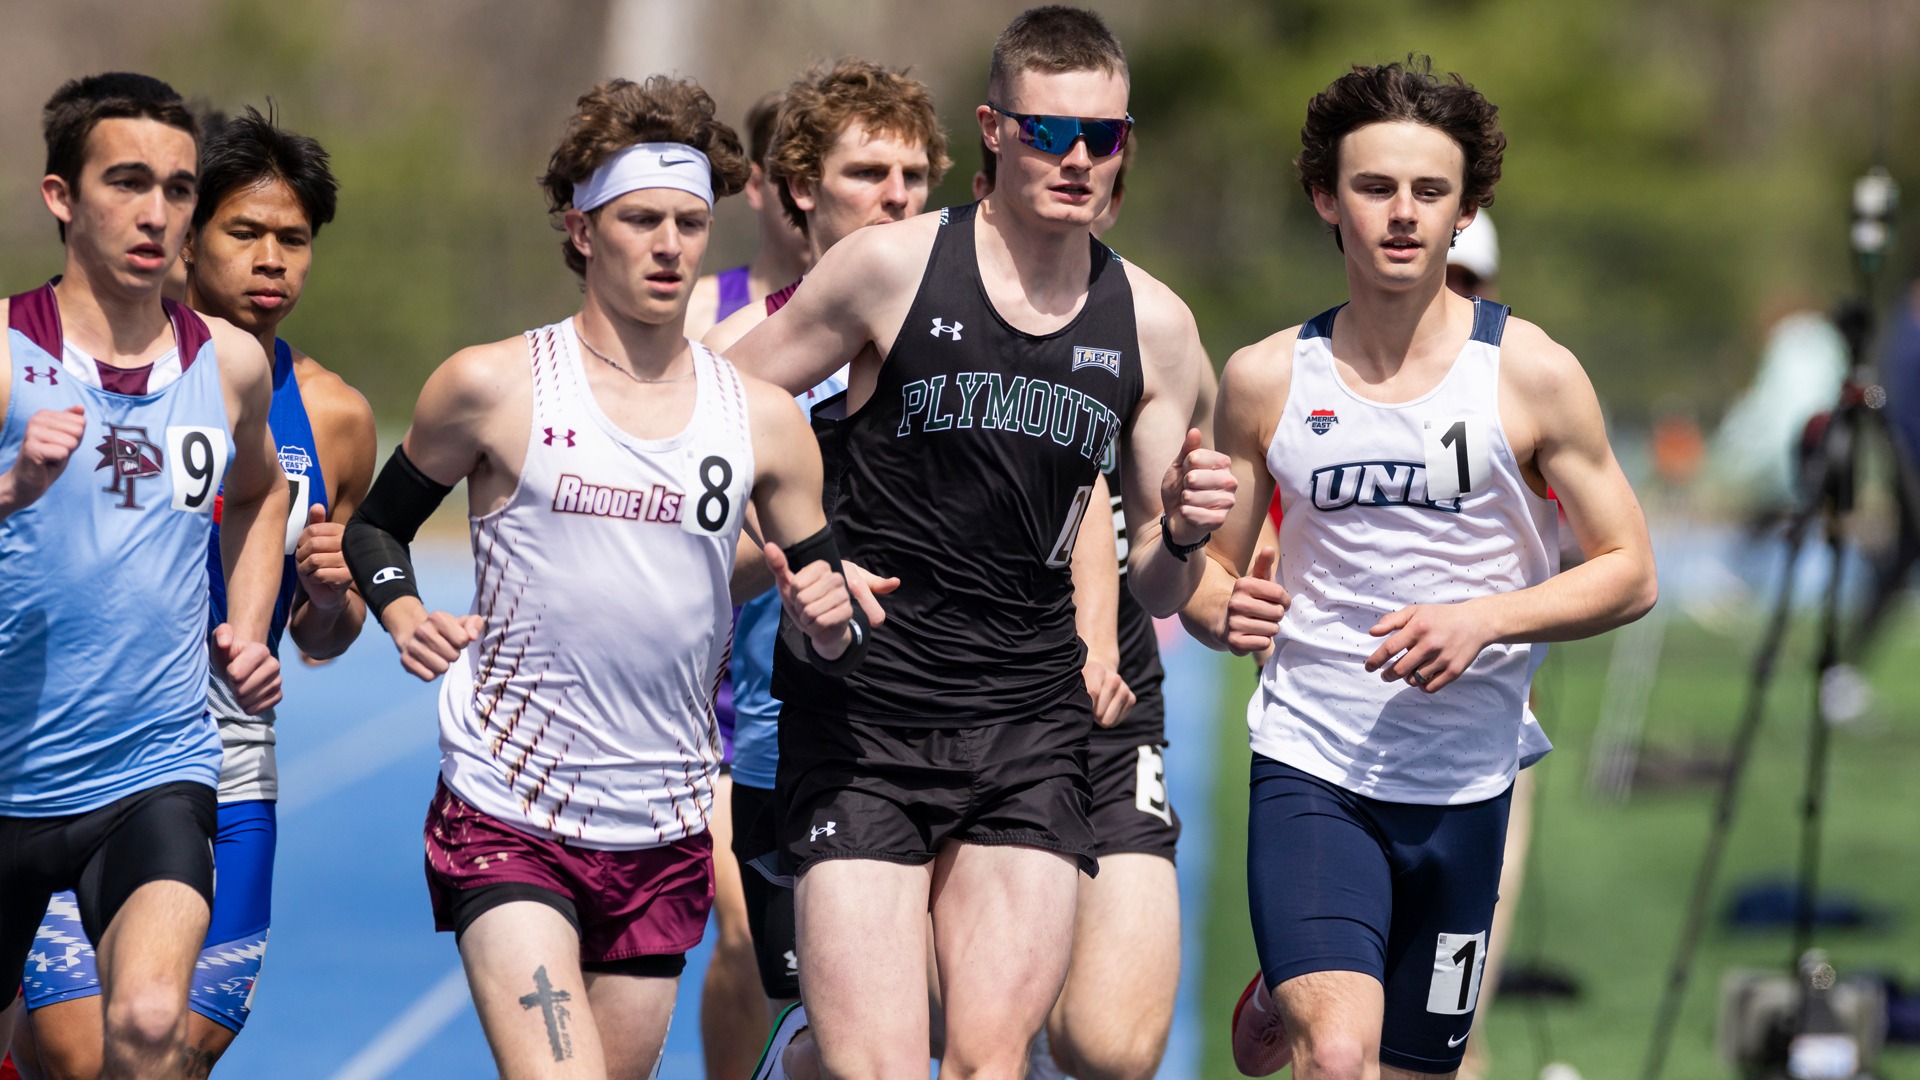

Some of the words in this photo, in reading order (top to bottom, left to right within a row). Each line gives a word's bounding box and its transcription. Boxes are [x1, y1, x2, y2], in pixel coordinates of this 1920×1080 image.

[1076, 350, 1118, 371] LEC
[897, 372, 1122, 470] PLYMOUTH
[1305, 416, 1339, 425] AMERICA
[182, 431, 214, 508] 9
[278, 453, 310, 463] AMERICA
[285, 461, 303, 469] EAST
[1440, 421, 1471, 494] 1
[697, 455, 733, 533] 8
[1452, 940, 1477, 1011] 1
